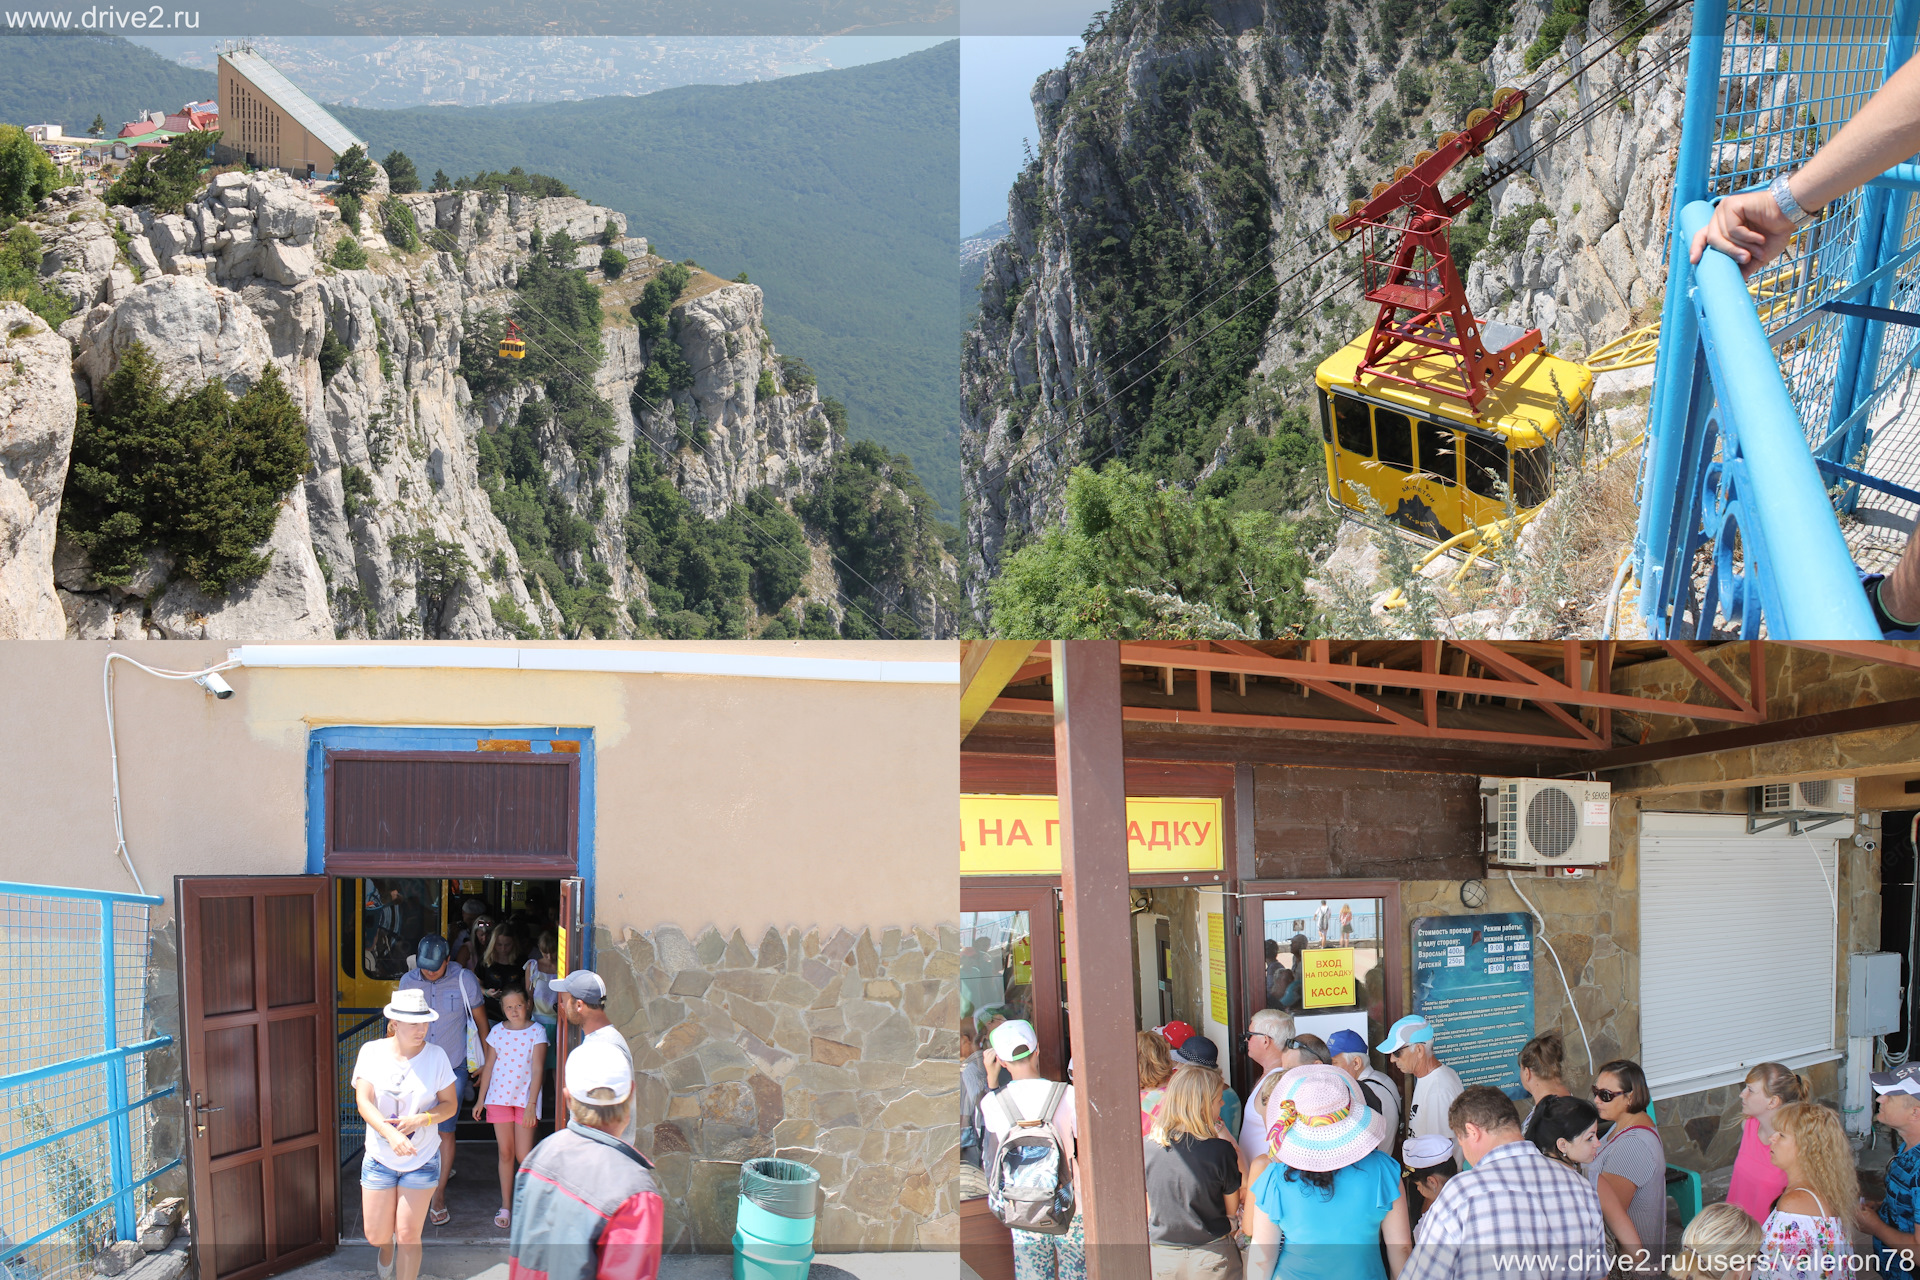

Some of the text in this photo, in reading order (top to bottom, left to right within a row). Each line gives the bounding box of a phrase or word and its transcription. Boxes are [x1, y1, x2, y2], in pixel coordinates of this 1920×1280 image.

[1592, 792, 1610, 800] SENSEI
[978, 818, 1033, 846] НА
[1046, 819, 1212, 851] ПАДКУ
[1502, 924, 1523, 932] работы:
[1419, 949, 1446, 958] Взрослый
[1316, 959, 1342, 968] ВХОД
[1484, 955, 1505, 963] верхней
[1418, 960, 1441, 970] Детский
[1312, 986, 1348, 997] КАССА
[1896, 1066, 1920, 1080] SP
